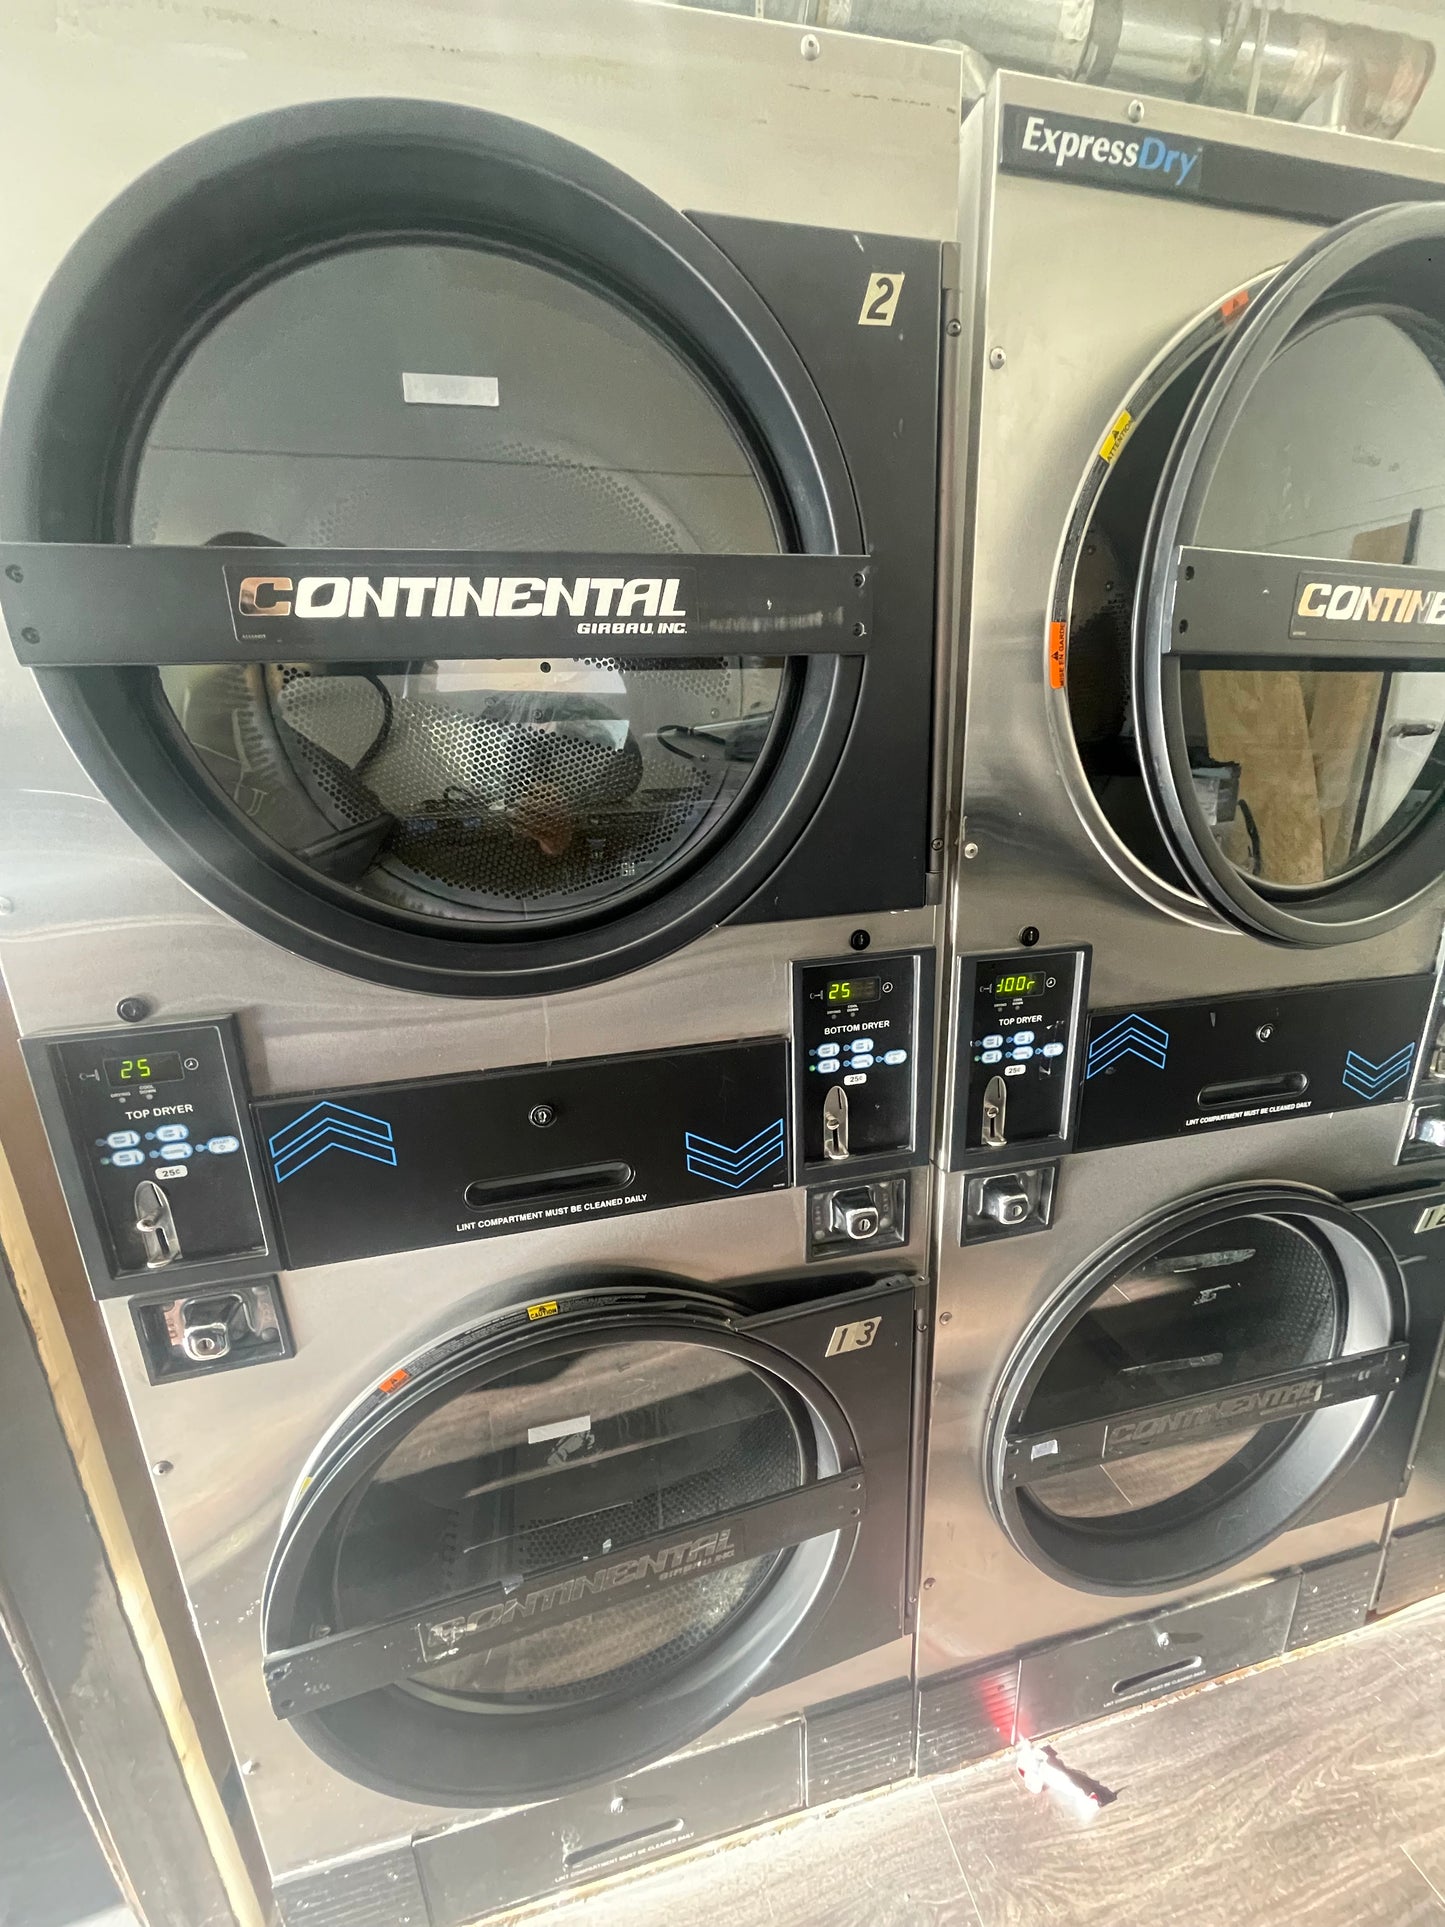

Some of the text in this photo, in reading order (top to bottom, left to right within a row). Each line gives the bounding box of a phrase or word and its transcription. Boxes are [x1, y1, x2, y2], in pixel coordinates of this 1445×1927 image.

[1022, 116, 1198, 186] ExpressDry
[867, 277, 894, 320] 2
[1106, 419, 1133, 462] ATTENTION
[239, 577, 687, 618] CONTINENTAL
[576, 622, 688, 635] GIRBAU, INC.
[828, 982, 850, 1000] 25
[824, 1020, 890, 1035] BOTTOM DRYER
[999, 1015, 1042, 1026] TOP DRYER
[120, 1058, 151, 1079] 25
[125, 1104, 194, 1120] TOP DRYER
[1185, 1118, 1200, 1126] LINT
[1243, 1109, 1260, 1117] MUST
[1268, 1103, 1296, 1113] CLEANED
[456, 1194, 648, 1232] LINT COMPARTMENT MUST BE CLEANED DAILY
[530, 1308, 557, 1319] CAUTION
[836, 1321, 875, 1352] 13
